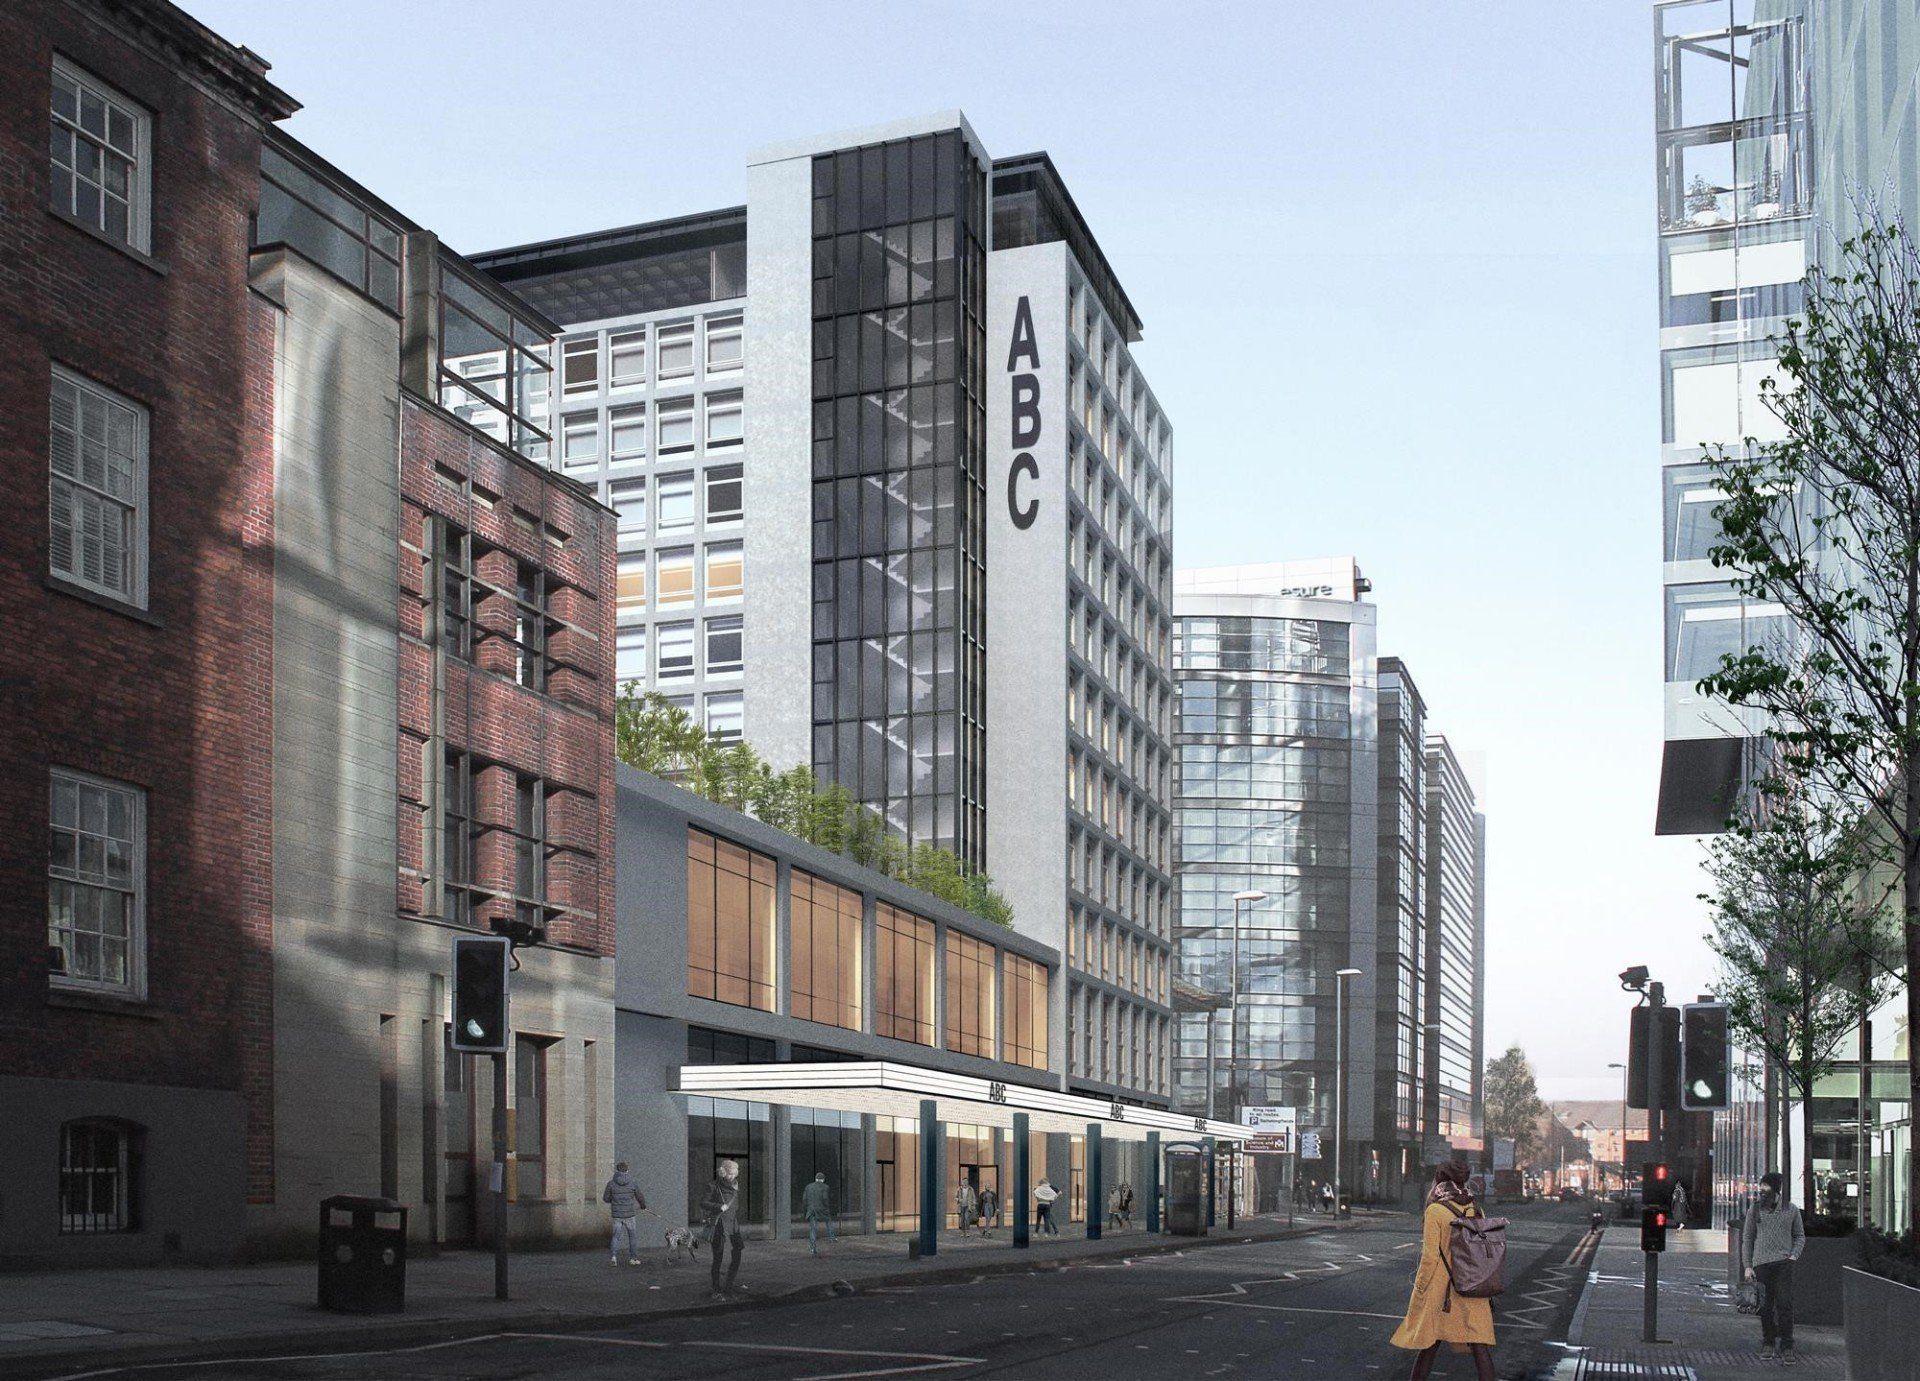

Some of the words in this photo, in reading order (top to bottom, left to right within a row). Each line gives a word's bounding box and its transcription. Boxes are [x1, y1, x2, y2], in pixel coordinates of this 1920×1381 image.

[1006, 295, 1041, 530] ABC
[989, 1081, 1007, 1104] ABC
[1110, 1103, 1124, 1120] ABC
[1194, 1118, 1208, 1131] ABC
